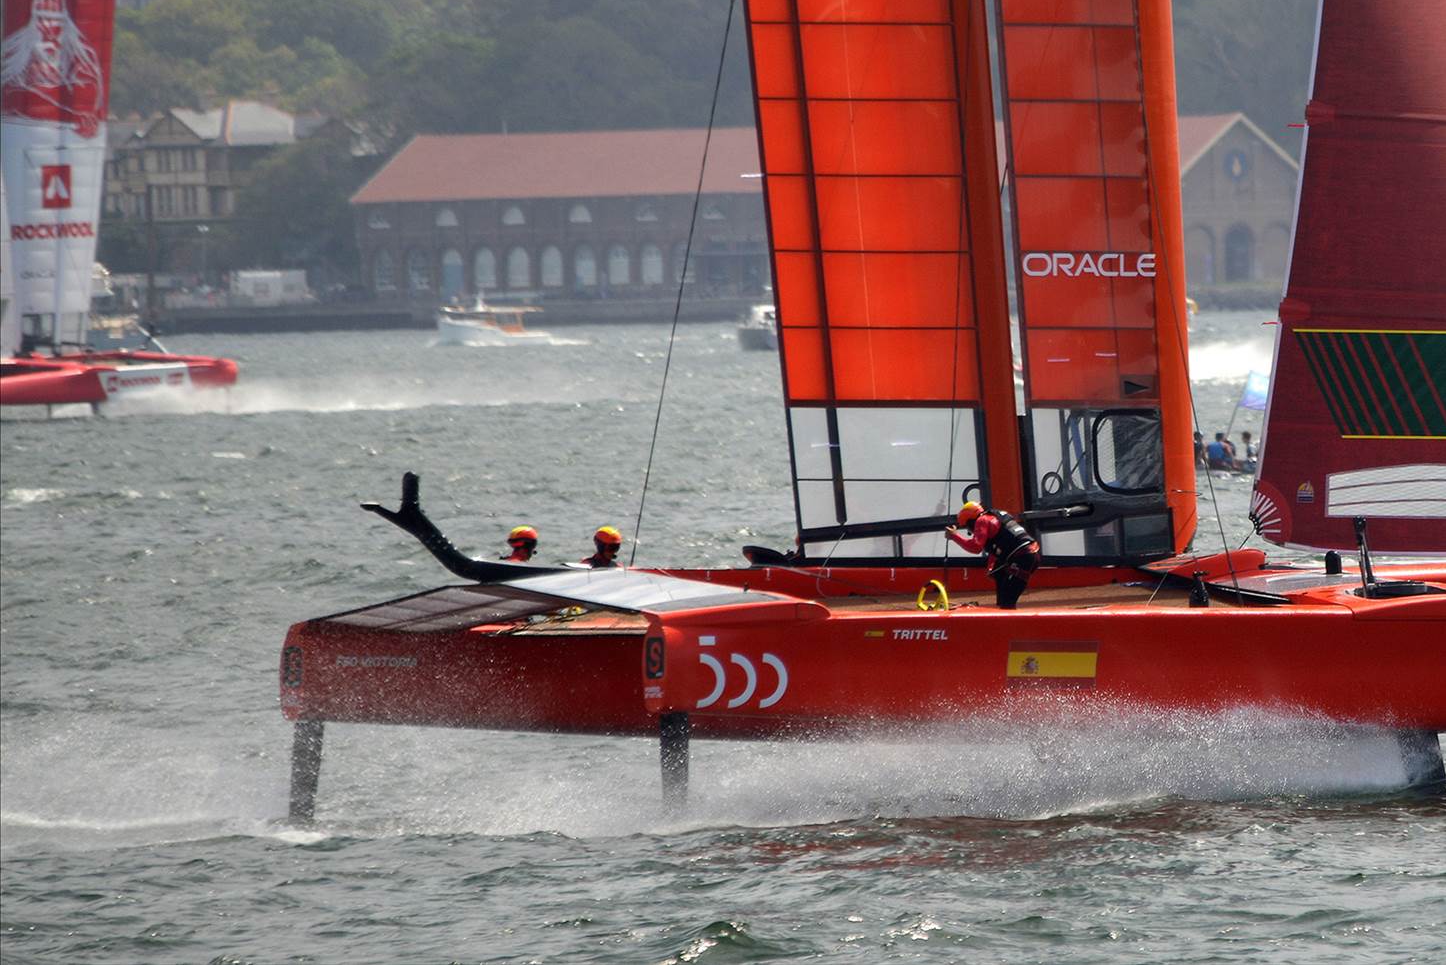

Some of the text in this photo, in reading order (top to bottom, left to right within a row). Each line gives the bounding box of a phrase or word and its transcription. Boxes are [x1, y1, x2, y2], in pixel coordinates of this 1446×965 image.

[11, 221, 95, 240] ROCKWOOL
[1022, 252, 1157, 277] ORACLE
[892, 629, 949, 641] TRITTEL
